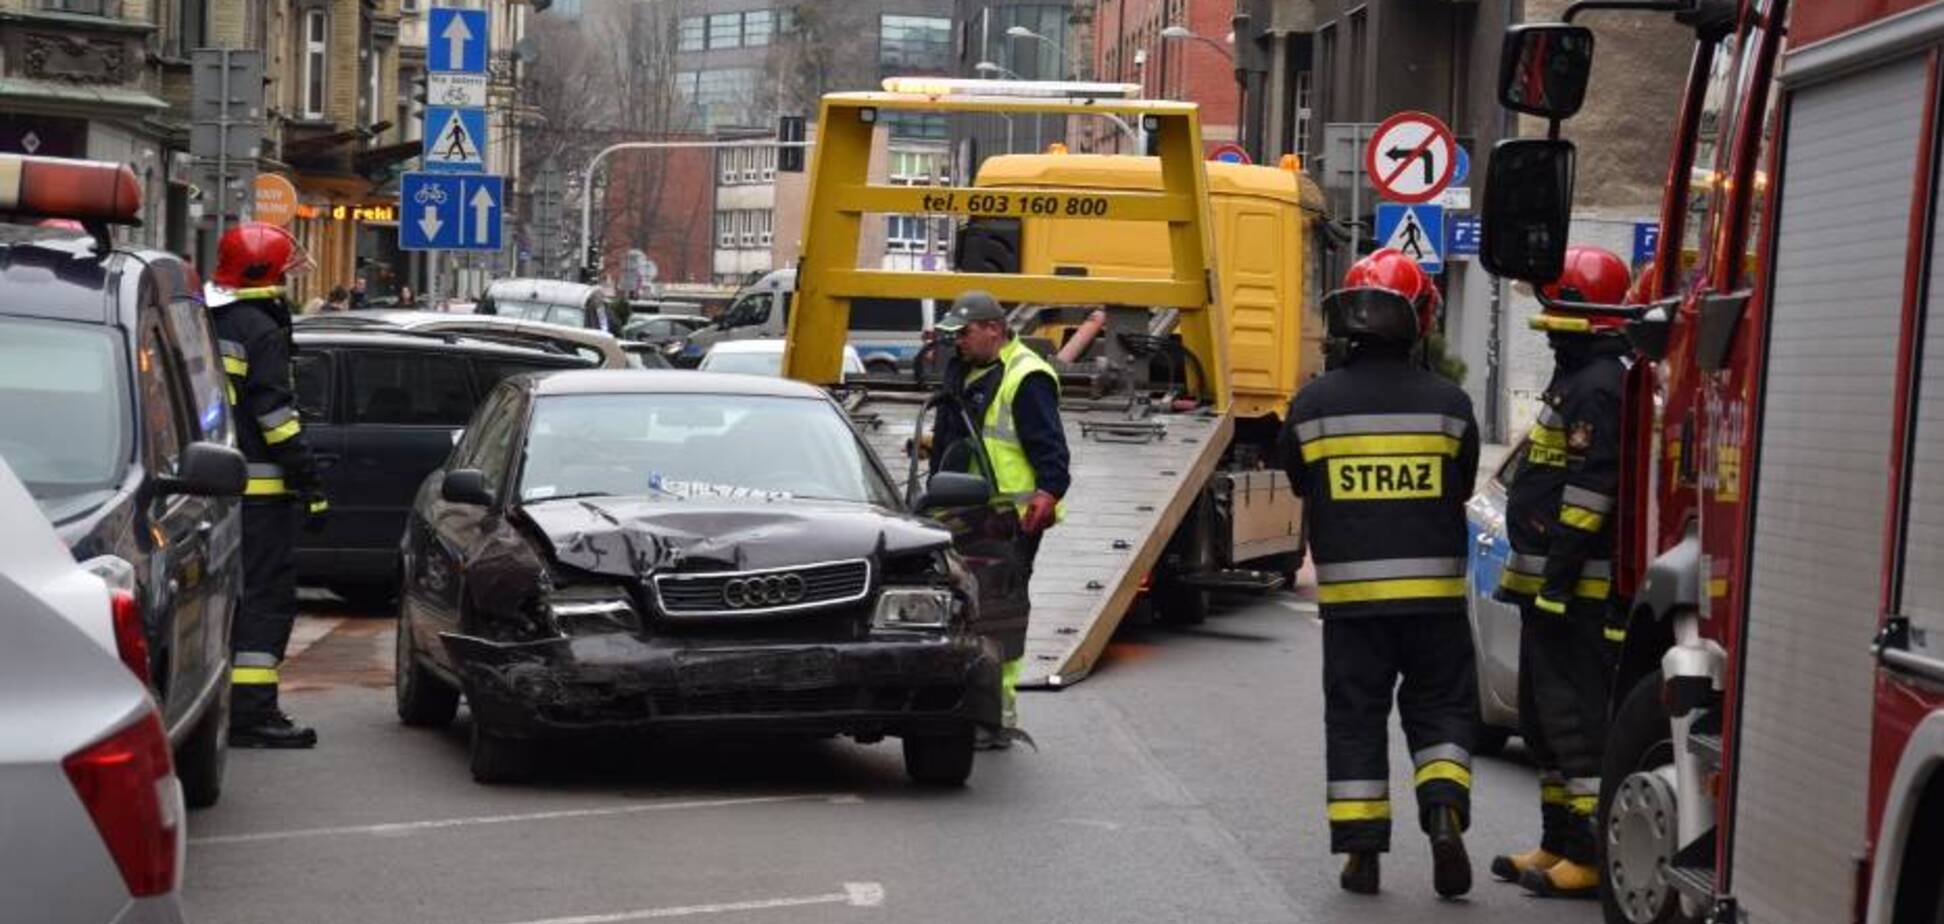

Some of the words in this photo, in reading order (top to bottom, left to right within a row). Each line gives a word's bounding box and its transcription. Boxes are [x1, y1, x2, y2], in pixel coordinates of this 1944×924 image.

[923, 193, 959, 212] tel.
[967, 195, 1009, 213] 603
[1018, 196, 1058, 214] 160
[1065, 197, 1108, 216] 800
[1340, 463, 1434, 492] STRAŻ
